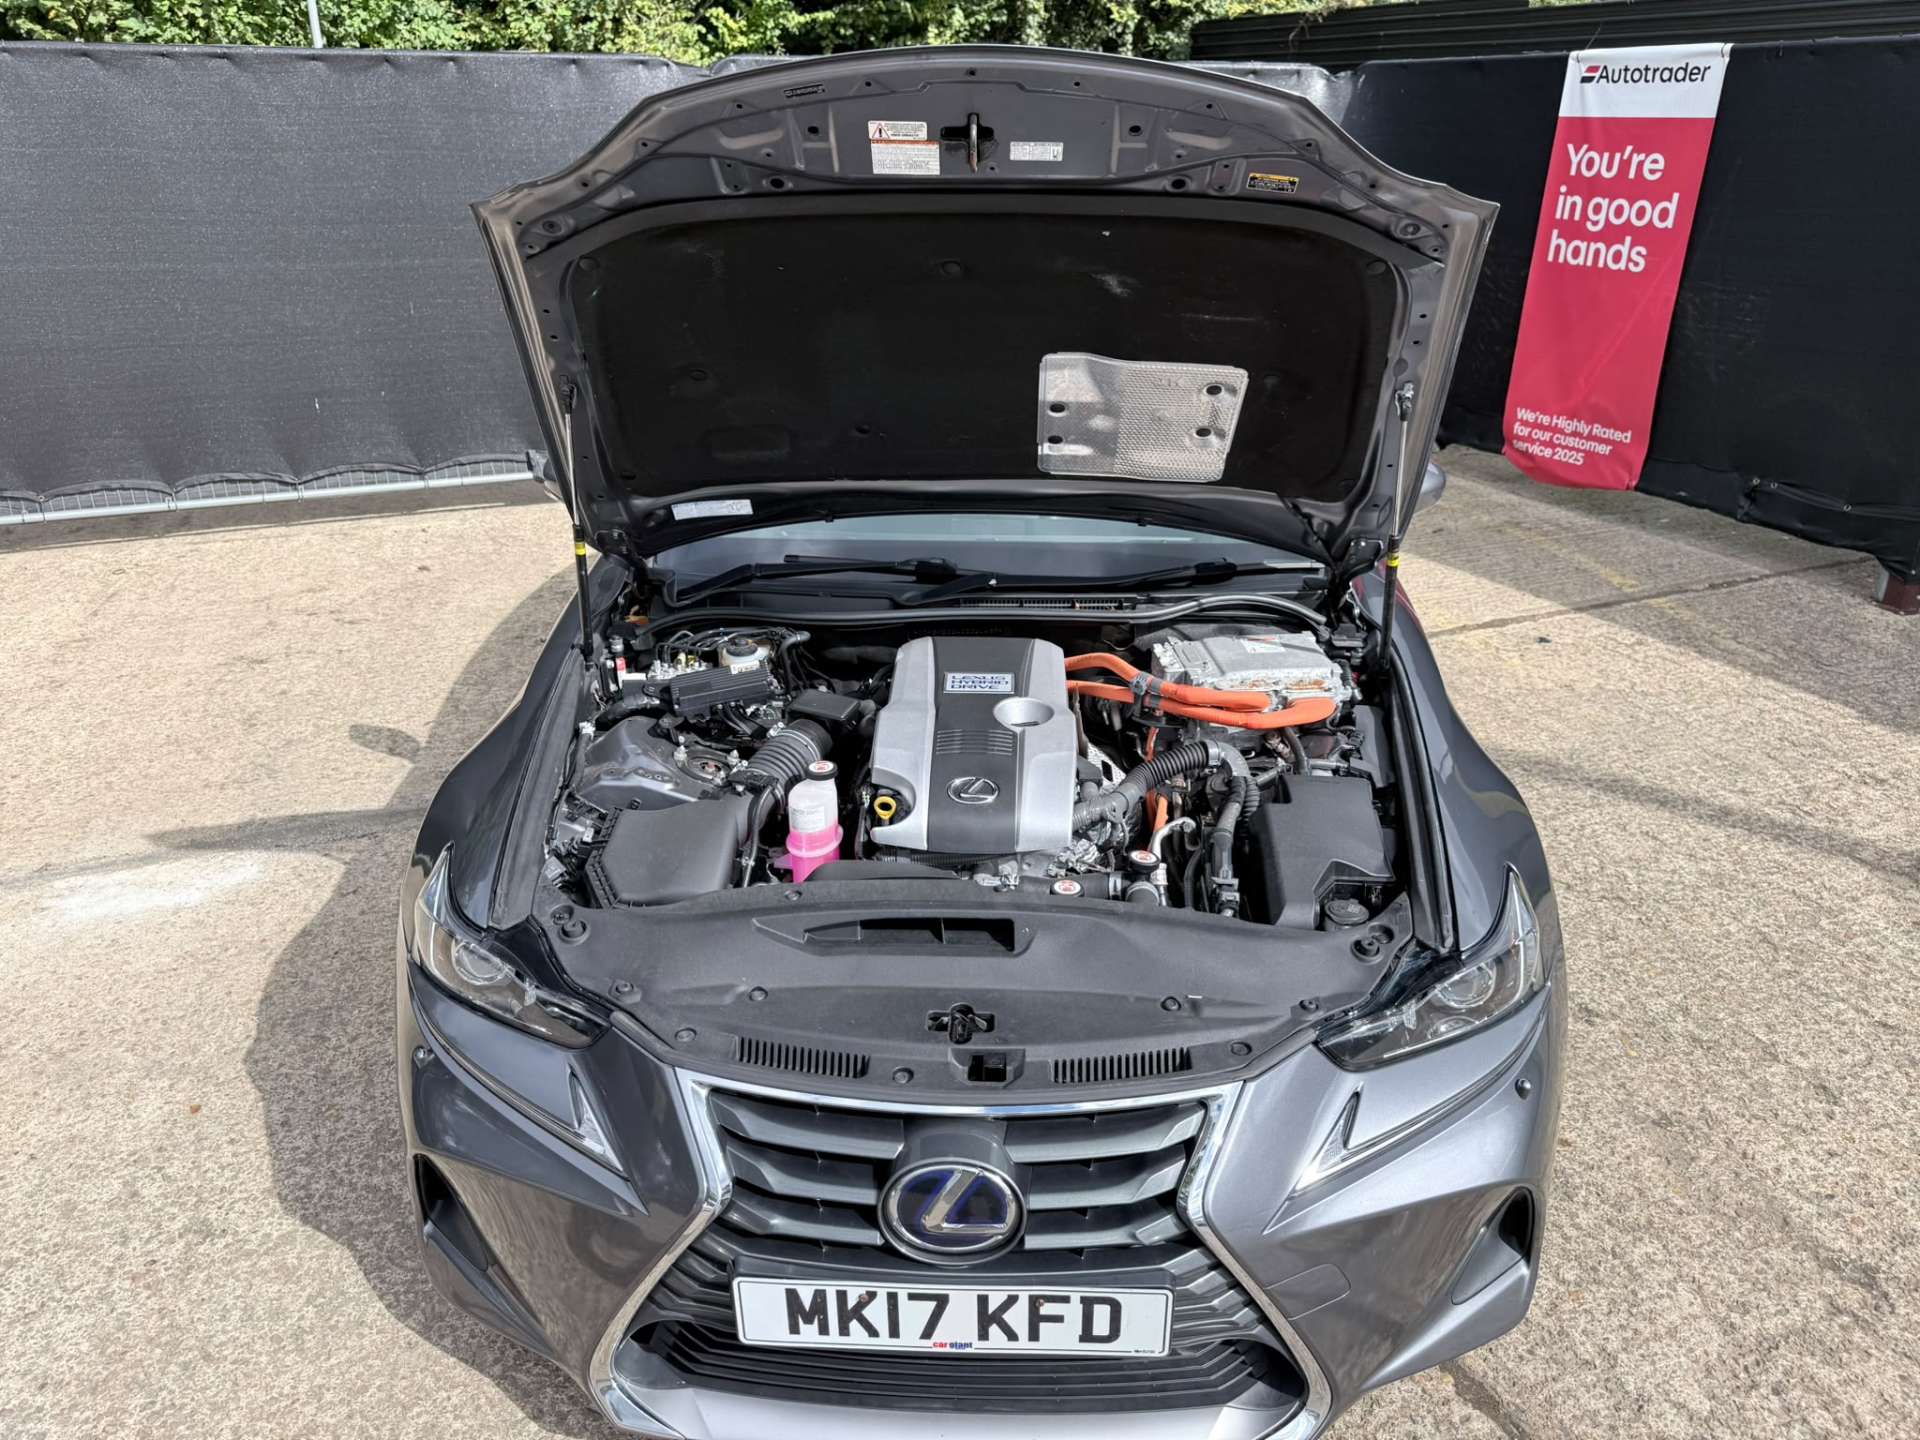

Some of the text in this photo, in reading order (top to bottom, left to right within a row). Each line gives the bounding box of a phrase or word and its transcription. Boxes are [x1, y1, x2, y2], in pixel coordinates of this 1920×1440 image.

[1597, 62, 1711, 84] Autotrader
[1567, 144, 1665, 181] You're
[1555, 185, 1680, 232] in good
[1547, 229, 1647, 273] hands
[1513, 421, 1613, 456] for our customer
[1516, 407, 1632, 443] We're Highly Rated
[1512, 439, 1585, 466] service 2025
[784, 1287, 1122, 1344] MK17 KFD
